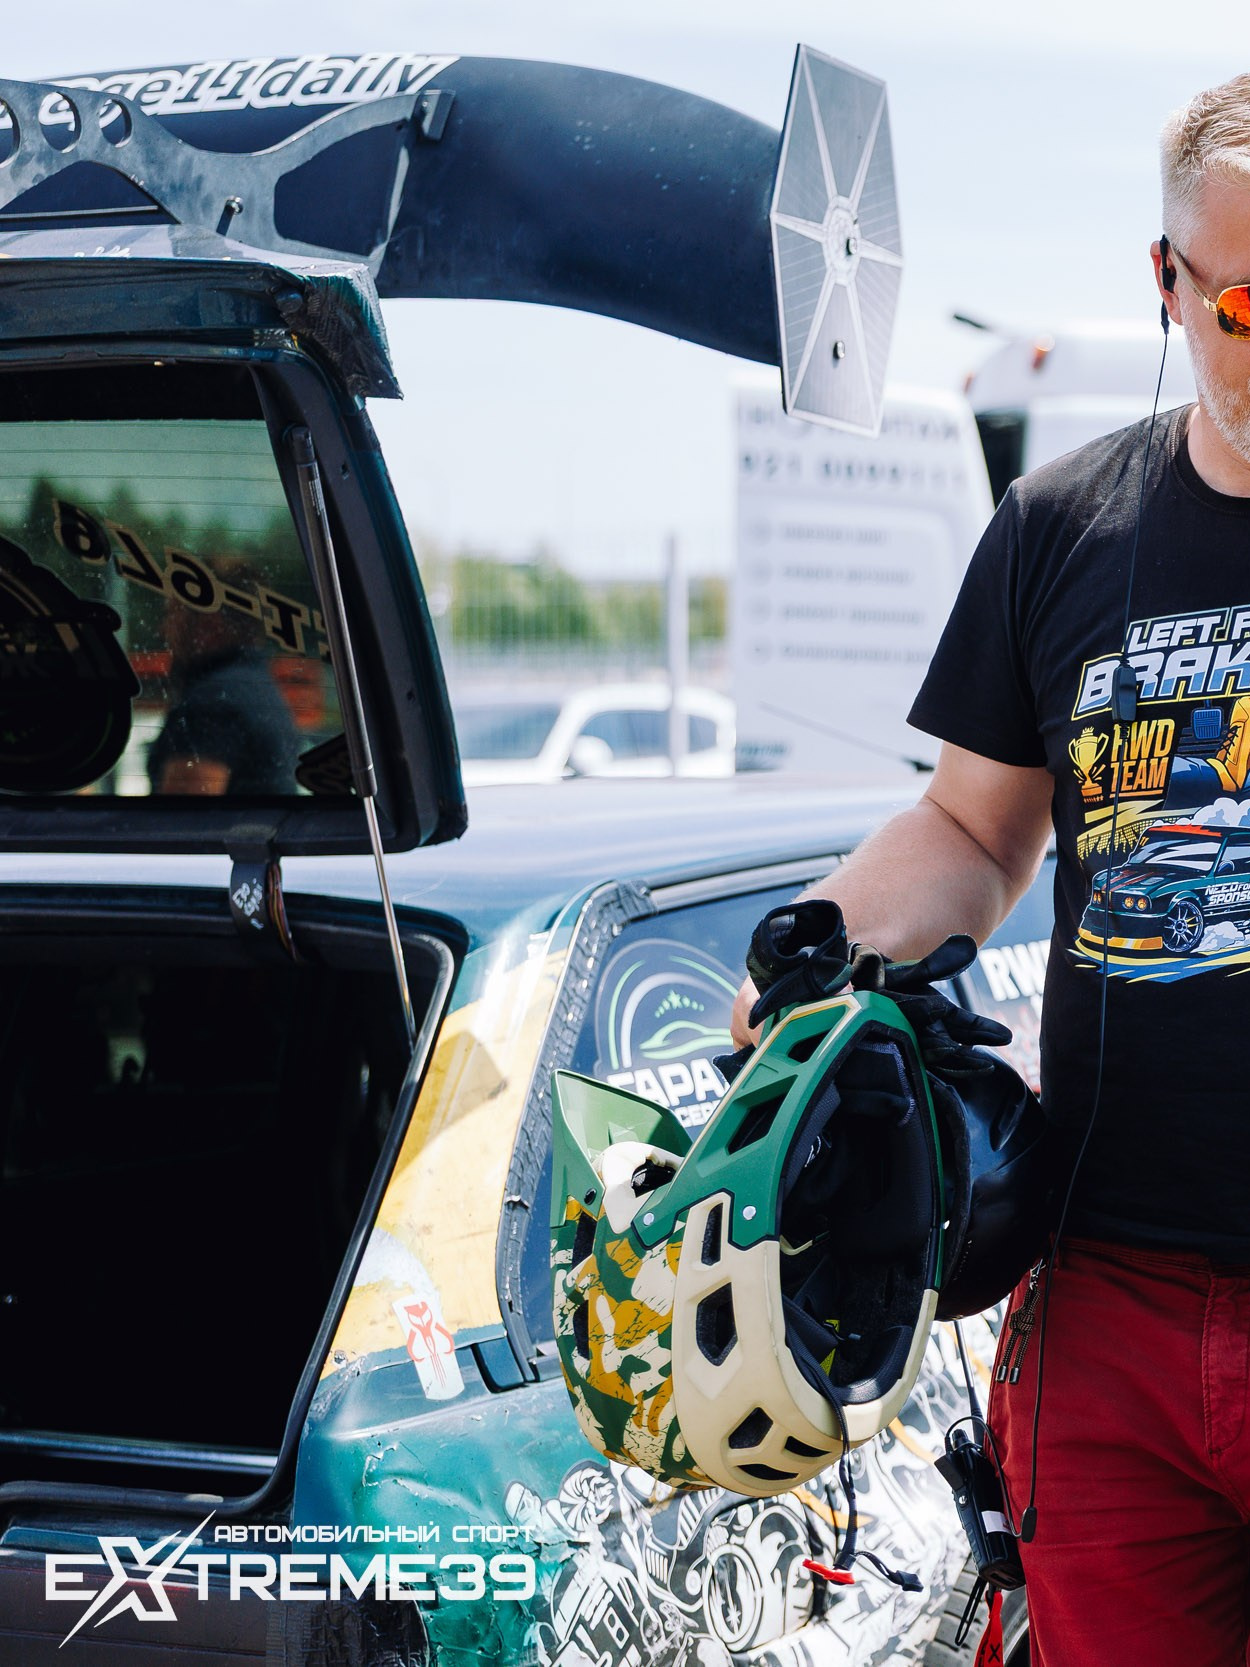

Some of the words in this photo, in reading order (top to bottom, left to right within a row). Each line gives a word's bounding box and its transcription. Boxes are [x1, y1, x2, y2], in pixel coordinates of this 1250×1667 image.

[1127, 616, 1222, 655] LEFT
[1110, 757, 1169, 792] TEAM
[1205, 882, 1239, 896] NEED
[978, 939, 1051, 1002] RW
[606, 1057, 731, 1108] ГАРА
